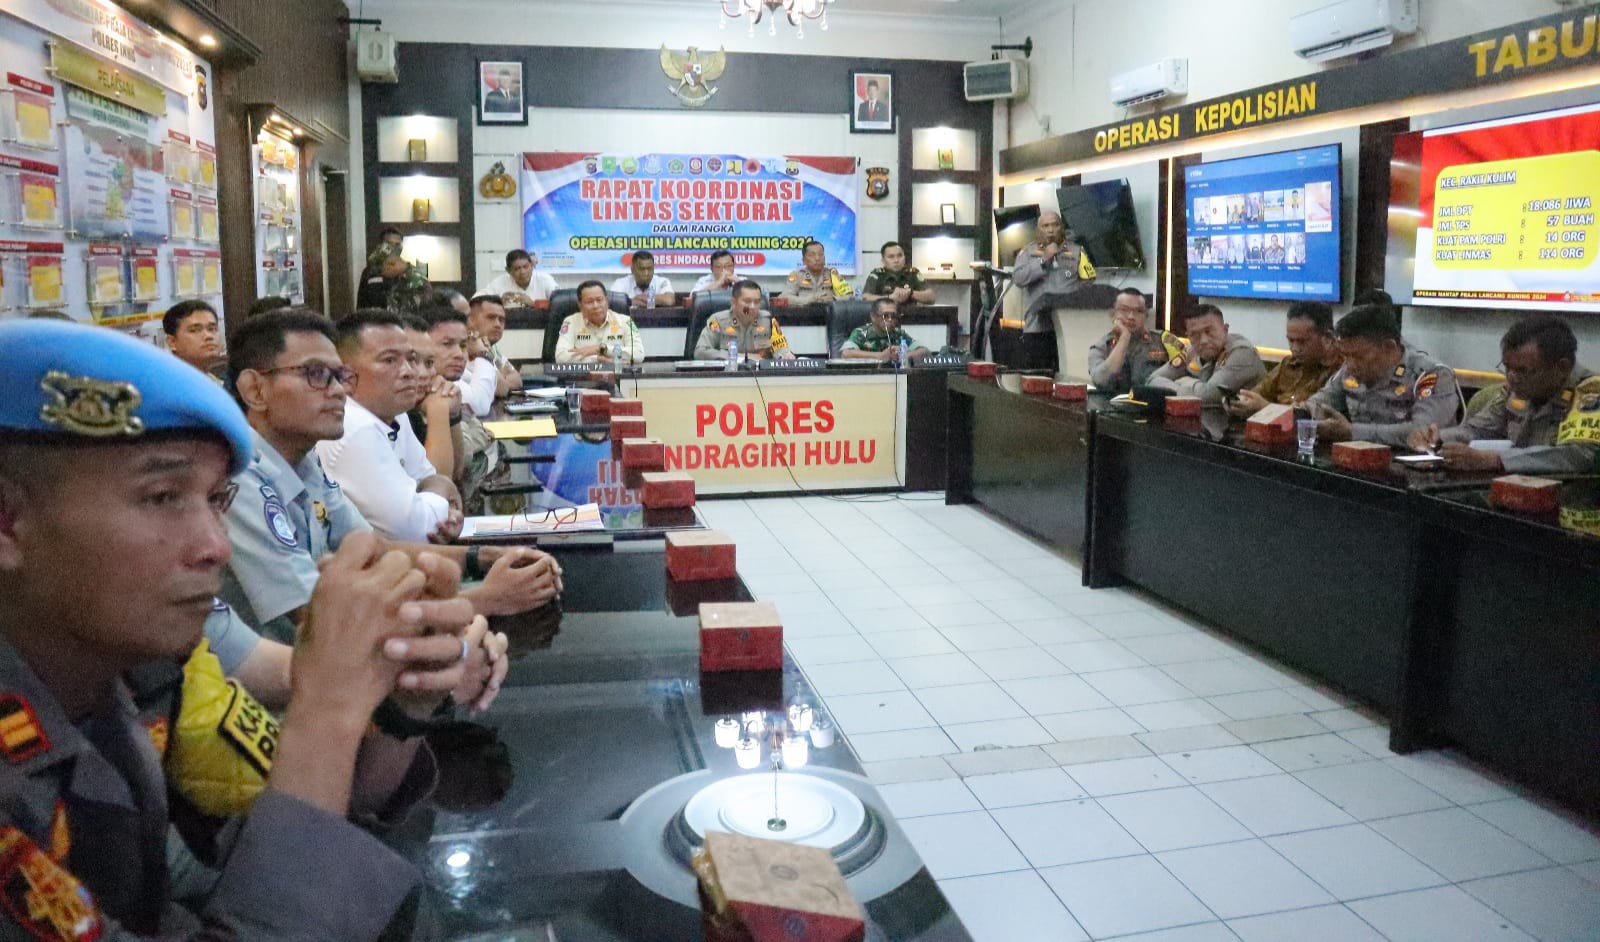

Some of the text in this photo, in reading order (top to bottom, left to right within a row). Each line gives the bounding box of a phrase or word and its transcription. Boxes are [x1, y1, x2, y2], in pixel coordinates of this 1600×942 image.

[1468, 14, 1600, 77] TABU
[1094, 82, 1317, 152] OPERASI KEPOLISIAN
[1440, 171, 1516, 189] KEC. RAKIT KULIM
[581, 180, 802, 200] RAPAT KOORDINASI
[593, 201, 792, 221] LINTAS SEKTORAL
[1456, 205, 1473, 216] DPT
[1528, 200, 1561, 211] 18.086
[1564, 197, 1591, 209] JIWA
[653, 225, 735, 233] DALAM RANGKA
[1454, 220, 1471, 230] TPS
[1547, 216, 1559, 226] 57
[1562, 214, 1594, 225] BUAH
[570, 237, 629, 250] OPERASI
[630, 237, 665, 250] LILIN
[666, 237, 729, 250] LANCANG
[731, 237, 780, 250] KUNING
[1437, 235, 1458, 245] KUAT
[1458, 235, 1479, 245] PAM
[1480, 233, 1506, 244] POLRI
[1546, 232, 1558, 242] 14
[1562, 231, 1585, 242] ORG
[653, 255, 671, 265] RES
[736, 255, 755, 265] ULU
[1436, 250, 1457, 260] KUAT
[1458, 250, 1491, 260] LINMAS
[1539, 249, 1557, 259] 114
[1560, 248, 1584, 258] ORG
[696, 400, 835, 438] POLRES
[663, 439, 876, 470] NDRAGIRI HULU
